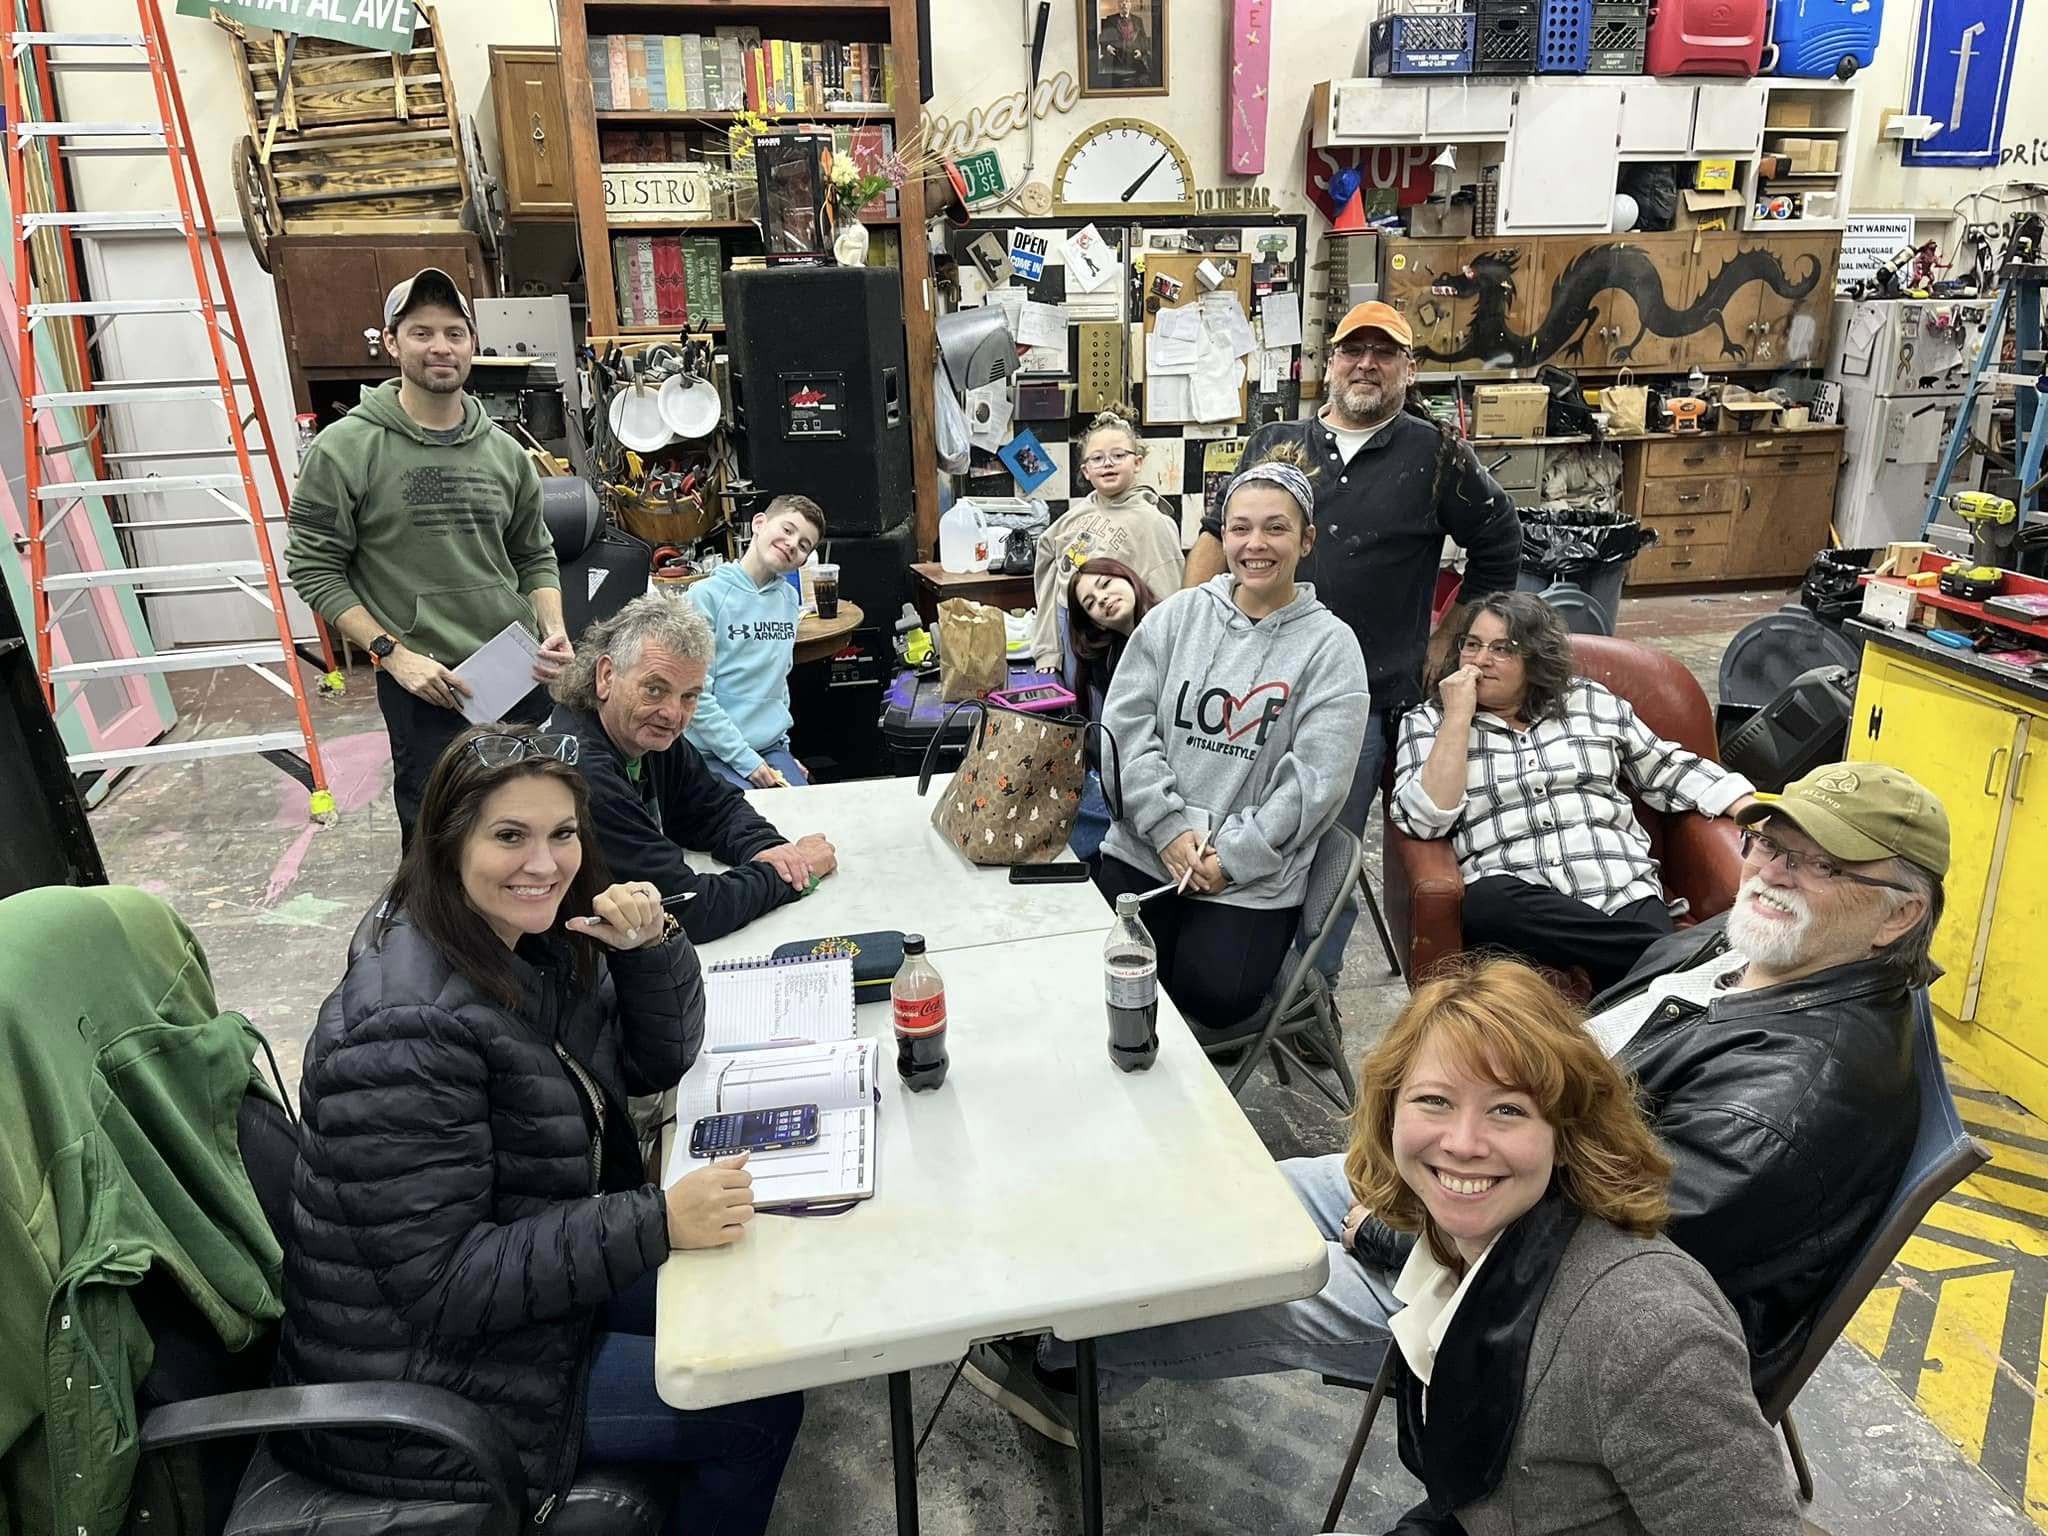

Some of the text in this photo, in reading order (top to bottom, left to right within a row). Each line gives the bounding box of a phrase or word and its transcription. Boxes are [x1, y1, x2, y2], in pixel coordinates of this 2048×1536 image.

[351, 0, 411, 35] AVE
[975, 157, 994, 177] DR
[981, 172, 1000, 192] SE
[602, 179, 695, 206] BISTRO
[1196, 186, 1271, 210] TO THE BAR
[1866, 223, 1907, 233] WARNING
[1013, 231, 1049, 256] OPEN
[1857, 247, 1894, 255] LANGUAGE
[1010, 255, 1042, 274] COME IN
[753, 621, 794, 632] UNDER
[753, 632, 795, 641] ARMOUR
[1186, 735, 1257, 761] #ITSALIFESTYLE
